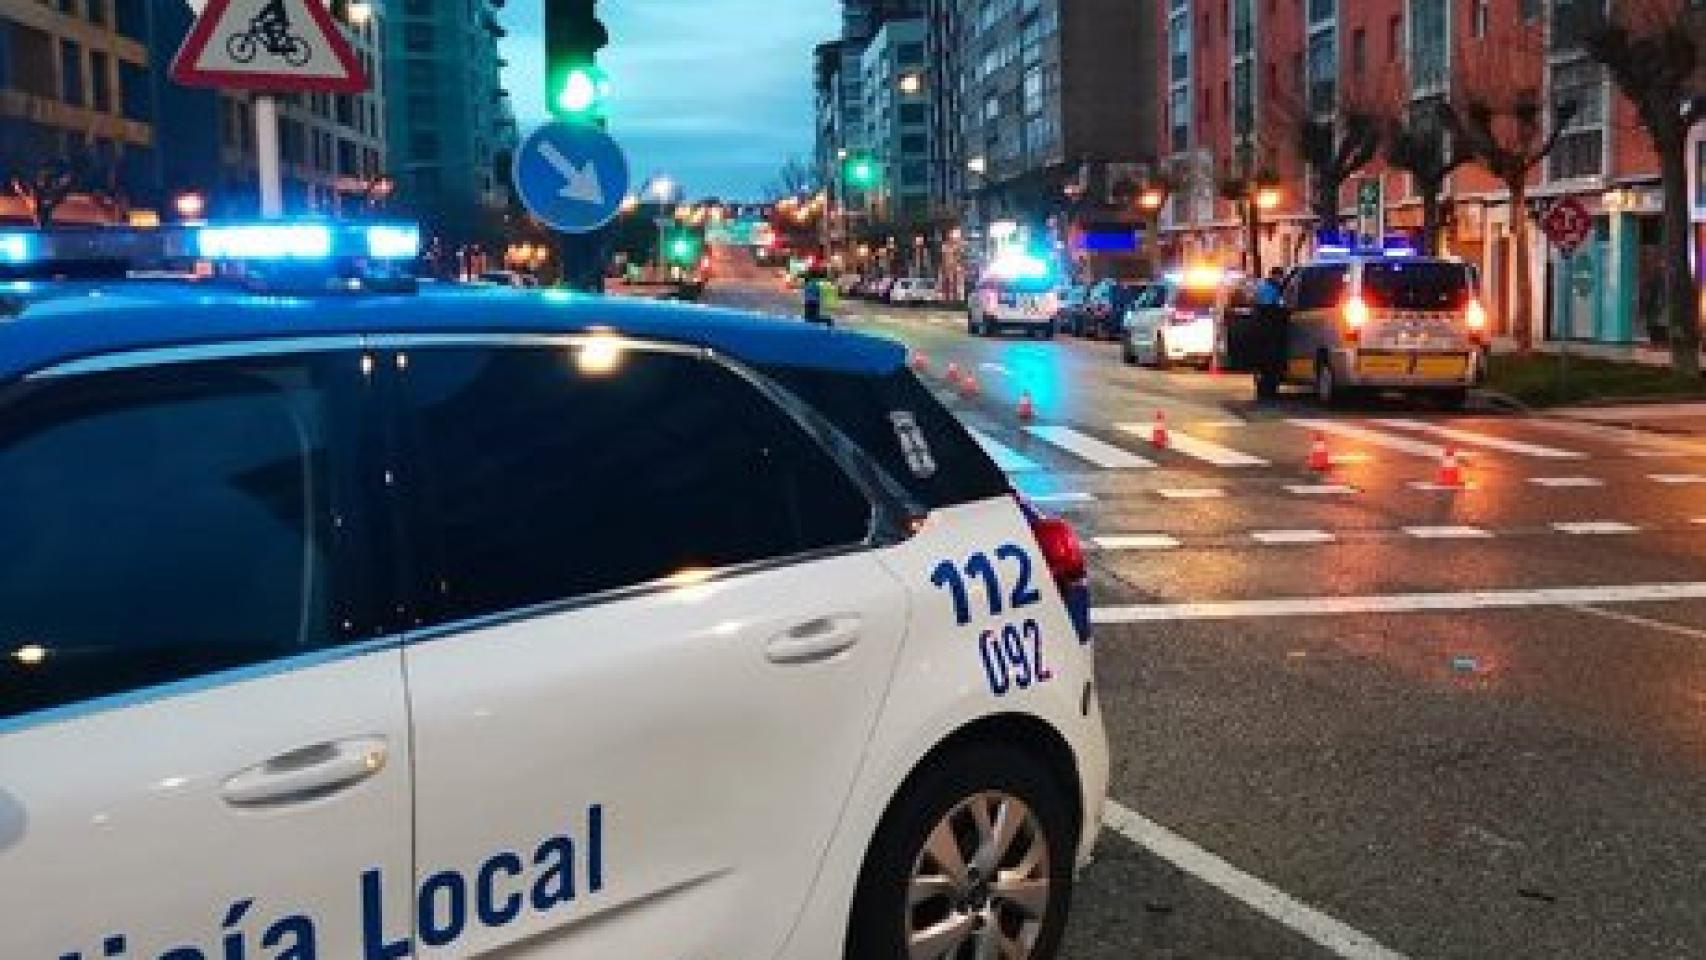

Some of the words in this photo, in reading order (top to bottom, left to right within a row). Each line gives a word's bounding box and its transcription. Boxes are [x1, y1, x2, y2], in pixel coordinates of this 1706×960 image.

[930, 543, 1041, 624] 112
[979, 618, 1052, 697] 092
[360, 803, 602, 960] Local
